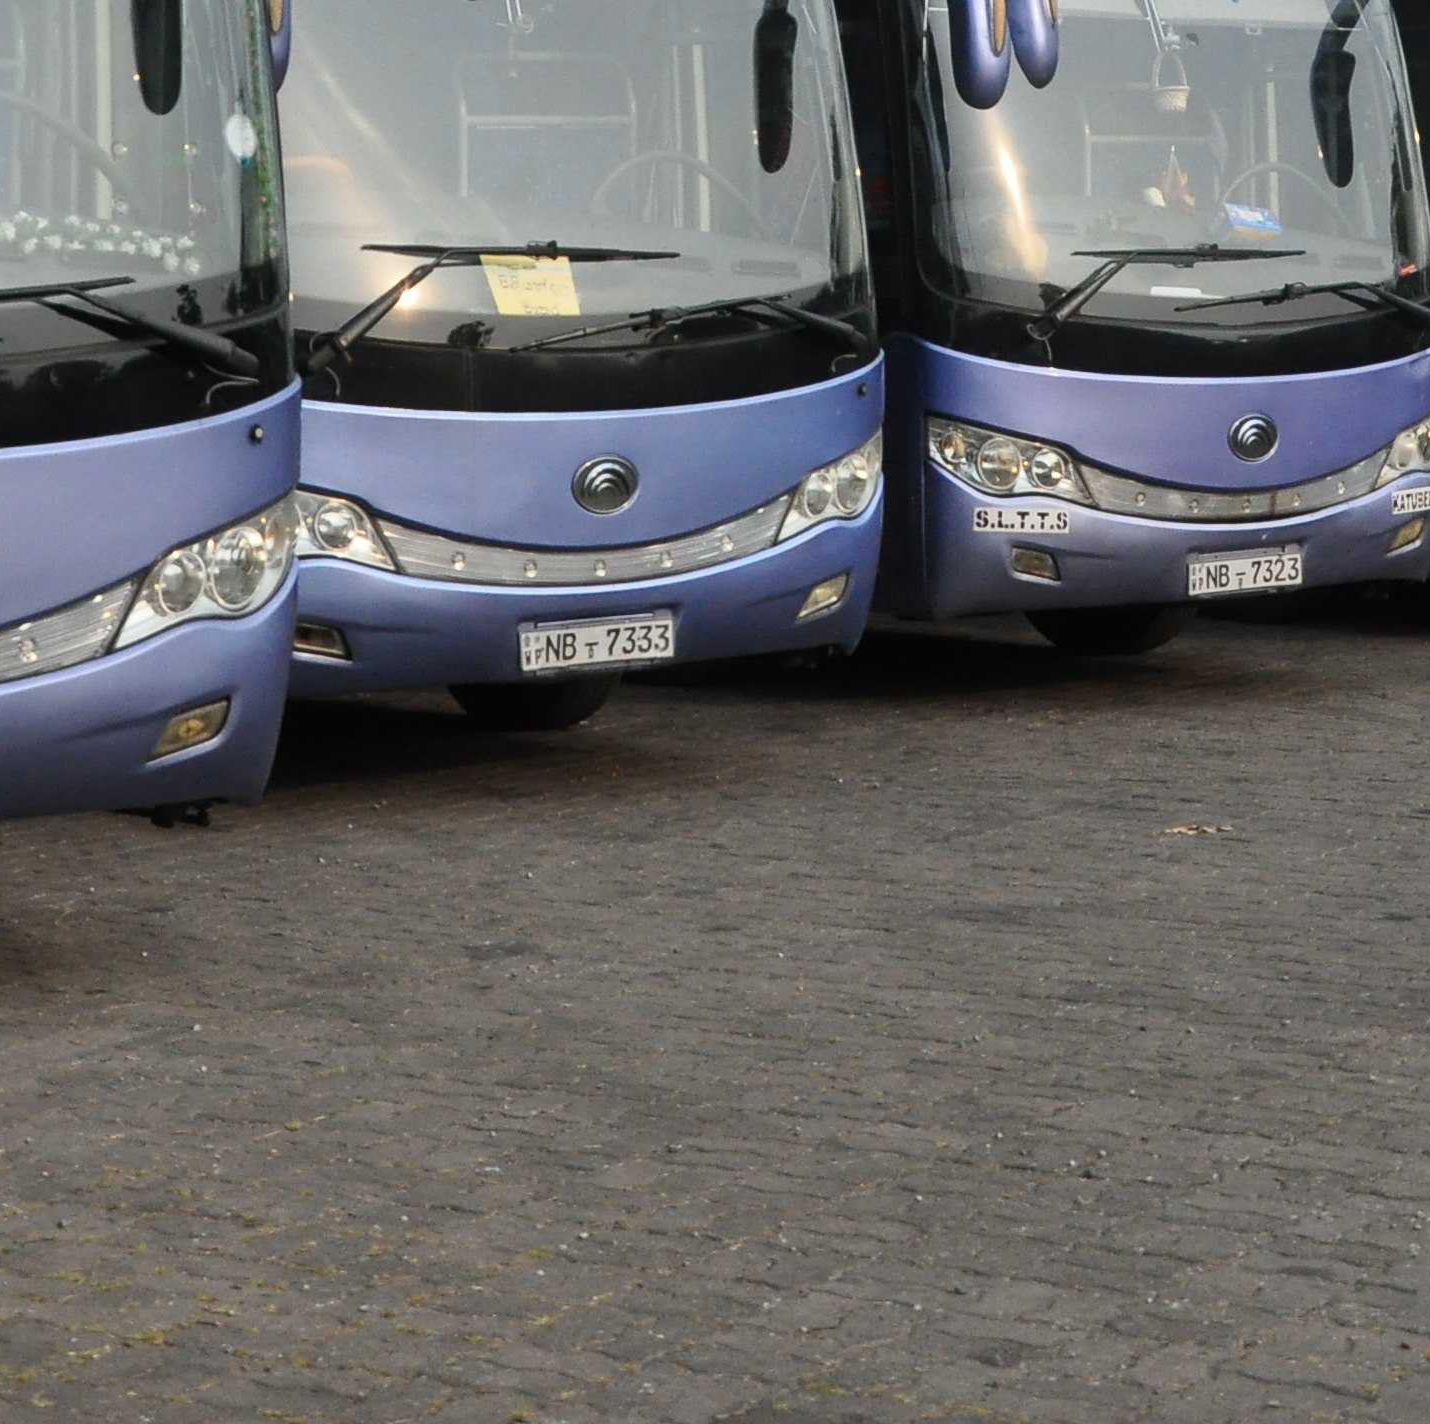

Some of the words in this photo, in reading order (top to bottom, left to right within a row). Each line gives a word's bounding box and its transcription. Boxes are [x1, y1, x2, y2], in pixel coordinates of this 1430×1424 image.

[975, 510, 1068, 530] S.L.T.T.S
[1251, 557, 1300, 585] 7323
[606, 624, 670, 656] 7333
